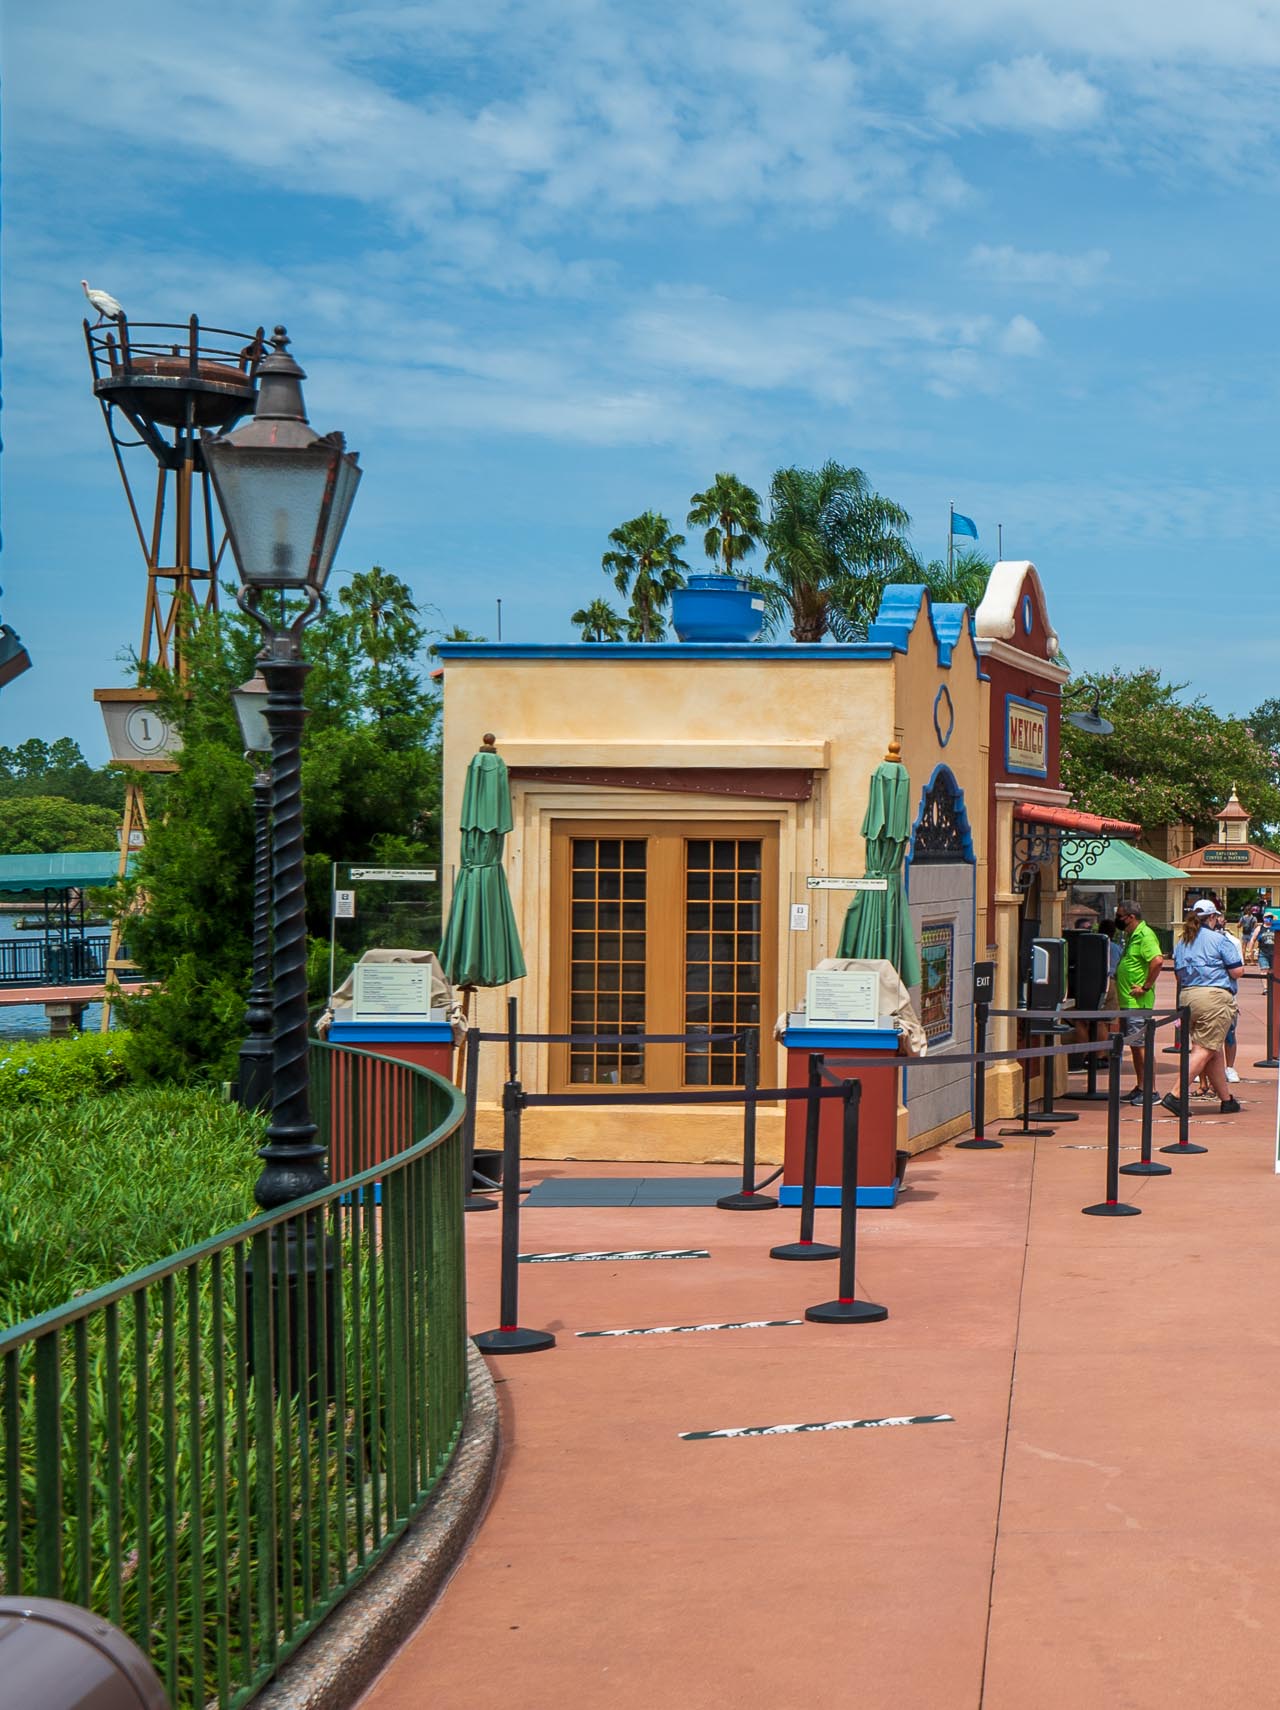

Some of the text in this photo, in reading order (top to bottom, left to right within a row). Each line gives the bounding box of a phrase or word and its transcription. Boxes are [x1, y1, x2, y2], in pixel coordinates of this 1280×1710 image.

[140, 718, 152, 741] 1
[1010, 716, 1043, 754] MEXICO
[976, 976, 990, 987] EXIT
[726, 1419, 914, 1438] PLEASE WAIT HERE
